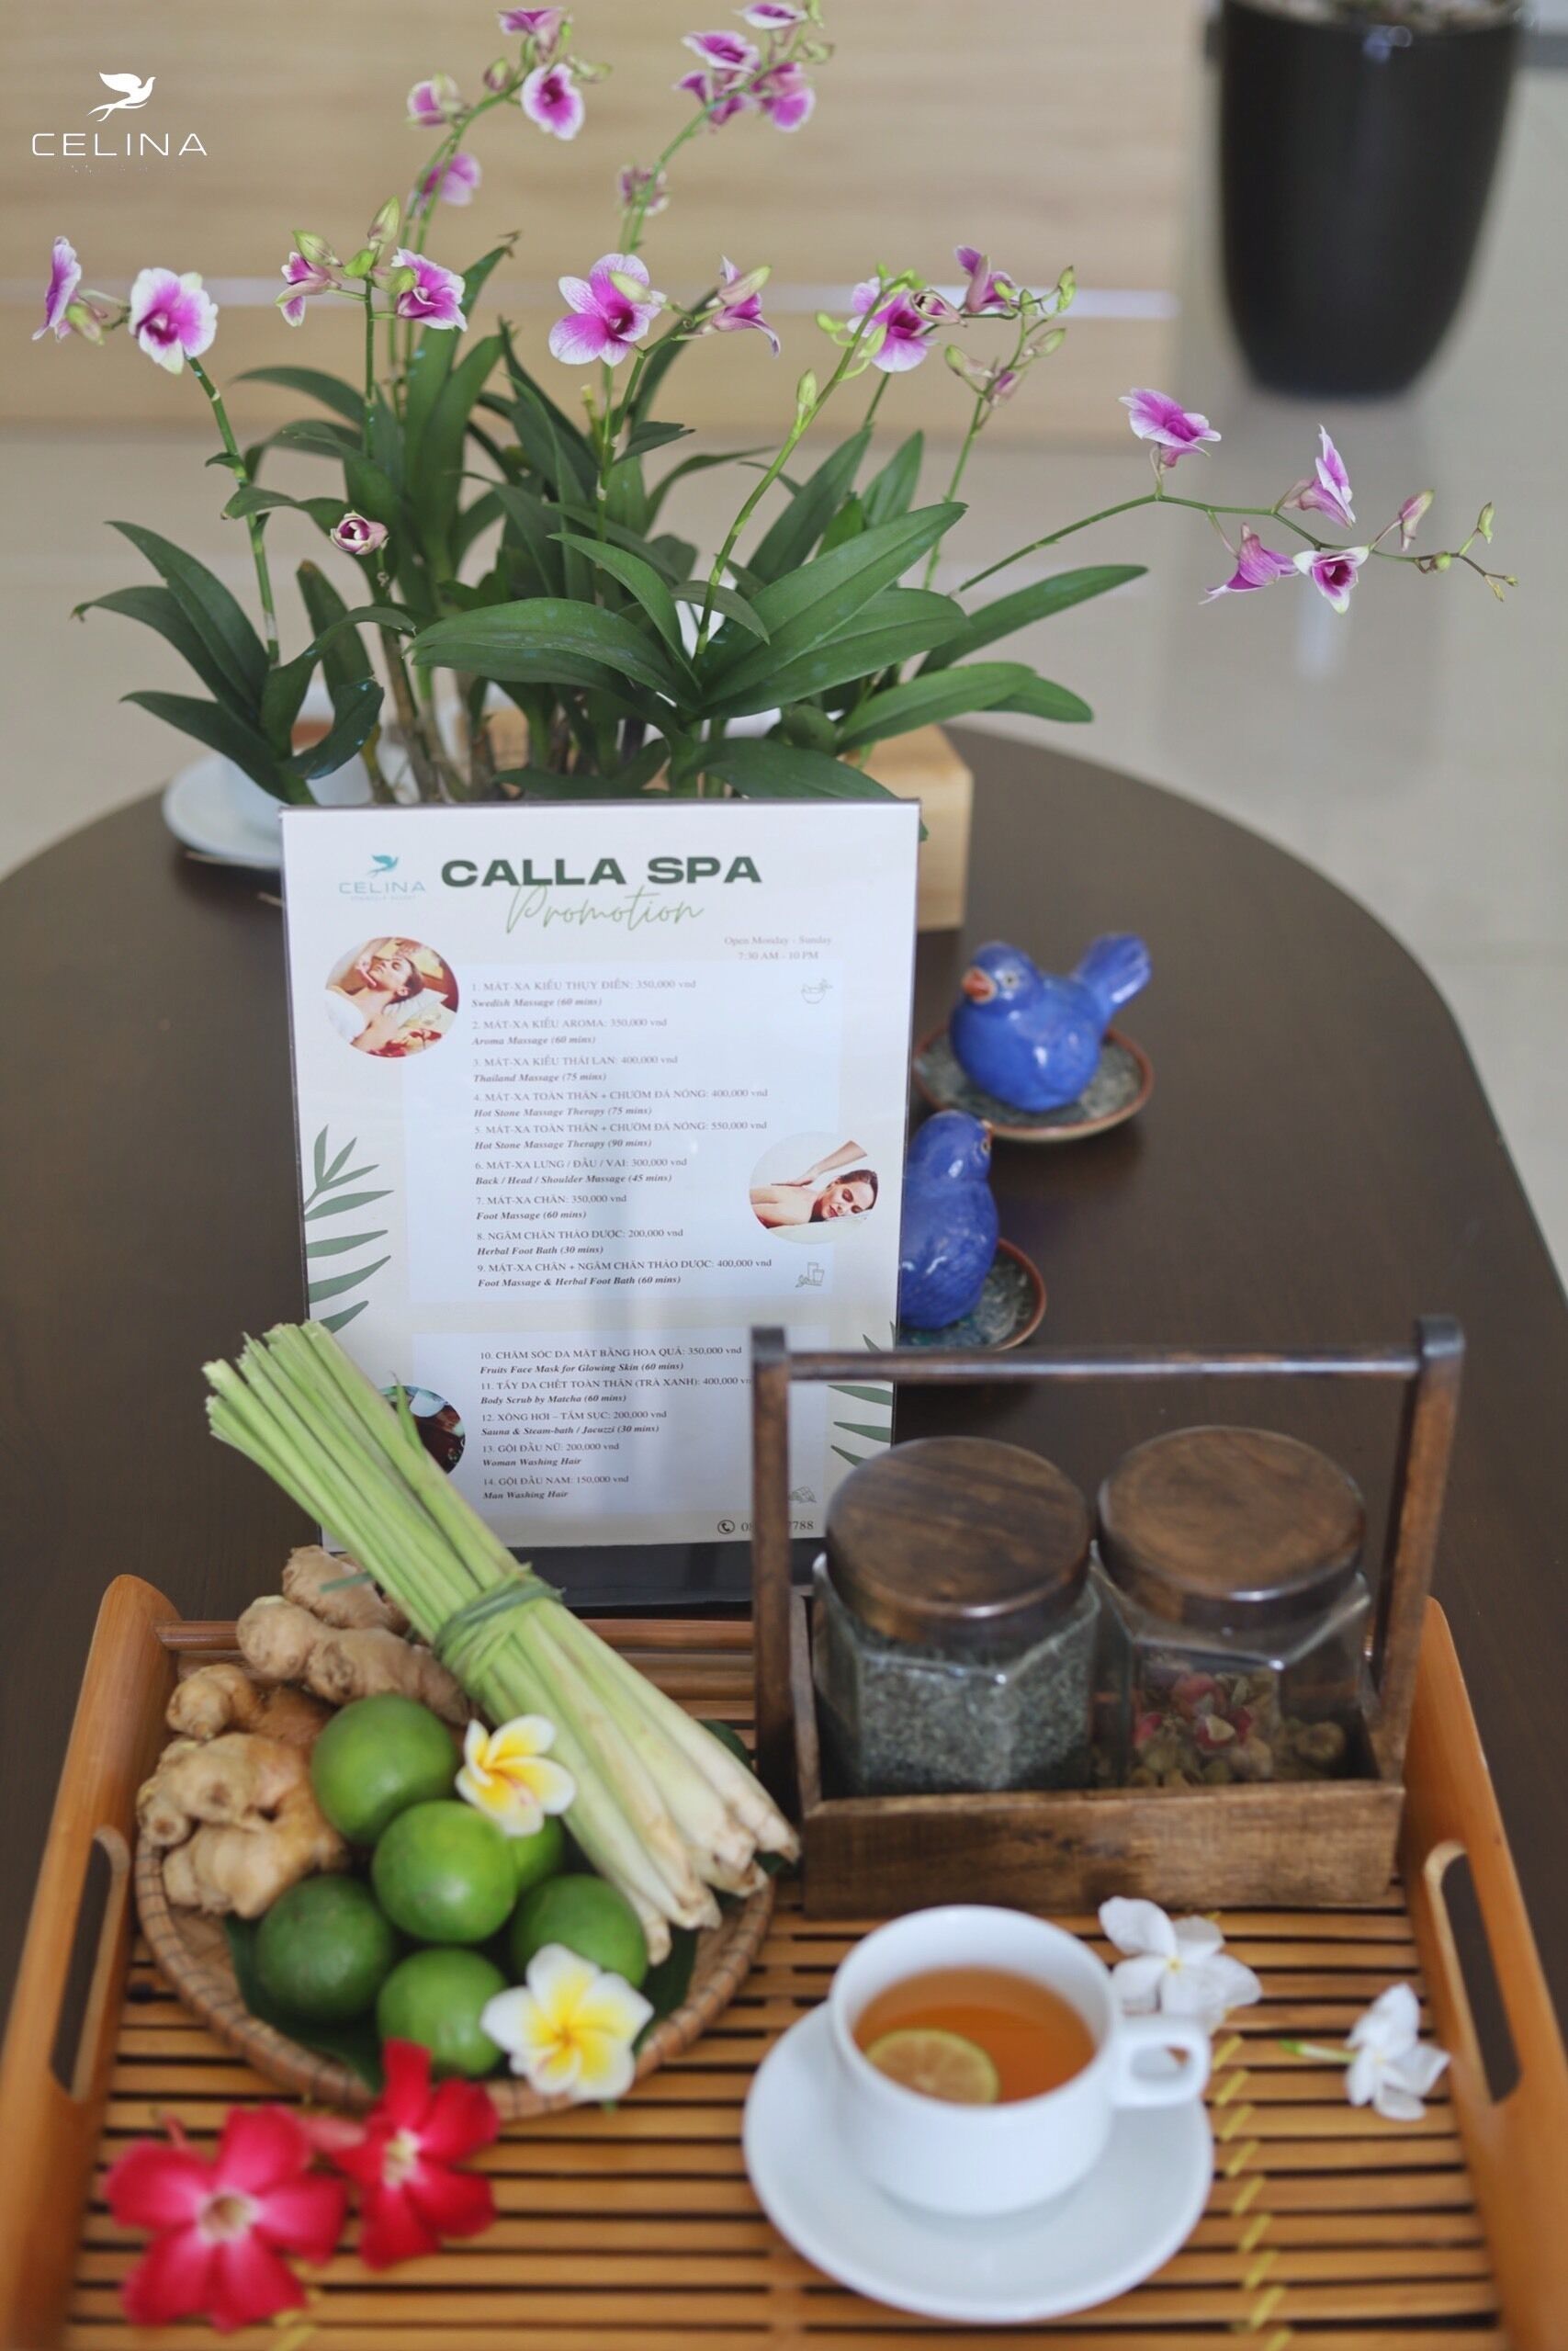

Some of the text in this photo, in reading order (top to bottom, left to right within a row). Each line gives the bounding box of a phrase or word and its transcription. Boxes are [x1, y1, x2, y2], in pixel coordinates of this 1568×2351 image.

[441, 856, 762, 887] CALLA SPA
[338, 880, 425, 895] CELINA
[506, 883, 705, 933] Promotion
[678, 979, 696, 989] vnd
[470, 998, 603, 1009] Swedish Massage (60 mins)
[562, 1017, 667, 1028] AROMA: vnd
[472, 1034, 595, 1046] Aroma Massage (60 mins)
[660, 1055, 678, 1063] vnd
[474, 1072, 606, 1083] Thailand Massage (75 mins)
[750, 1088, 768, 1097] vnd
[474, 1107, 652, 1118] Hot Stone Massage Therapy (75 mins)
[711, 1121, 748, 1131] 550,000
[750, 1120, 768, 1129] vnd
[474, 1139, 652, 1150] Hot Stone Massage Therapy (90 mins)
[606, 1159, 628, 1168] VAI:
[632, 1159, 667, 1169] 300,000
[671, 1158, 687, 1166] vnd
[476, 1174, 672, 1185] Back Head Shoulder Massage (45 mins)
[571, 1194, 608, 1204] 350,000
[610, 1193, 626, 1203] vnd
[476, 1210, 586, 1221] Foot Massage (60 mins)
[628, 1229, 665, 1239] 200,000
[667, 1228, 683, 1237] vnd
[478, 1245, 604, 1256] Herbal Foot Bath (30 mins)
[716, 1259, 753, 1269] 400,000
[755, 1258, 772, 1266] vnd
[478, 1275, 682, 1288] Foot Massage Herbal Foot Bath (60 mins)
[555, 1350, 570, 1359] DA
[632, 1348, 656, 1357] HOA
[687, 1347, 724, 1357] 350,000
[726, 1346, 742, 1354] vnd
[479, 1362, 683, 1374] Fruits Face Mask for Glowing Skin (60 mins)
[522, 1381, 536, 1390] DA
[702, 1377, 739, 1387] 400,000
[479, 1394, 626, 1406] Body Scrub by Matcha (60 mins)
[614, 1410, 649, 1420] 200,000
[650, 1409, 667, 1419] vnd
[481, 1425, 660, 1436] Sauna Steam-bath Jacuzzi (30 mins)
[566, 1442, 601, 1452] 200,000
[603, 1441, 619, 1451] vnd
[483, 1457, 581, 1468] Woman Washing Hair
[577, 1475, 612, 1486] 150,000
[612, 1475, 630, 1484] vnd
[483, 1490, 568, 1501] Man Washing Hair
